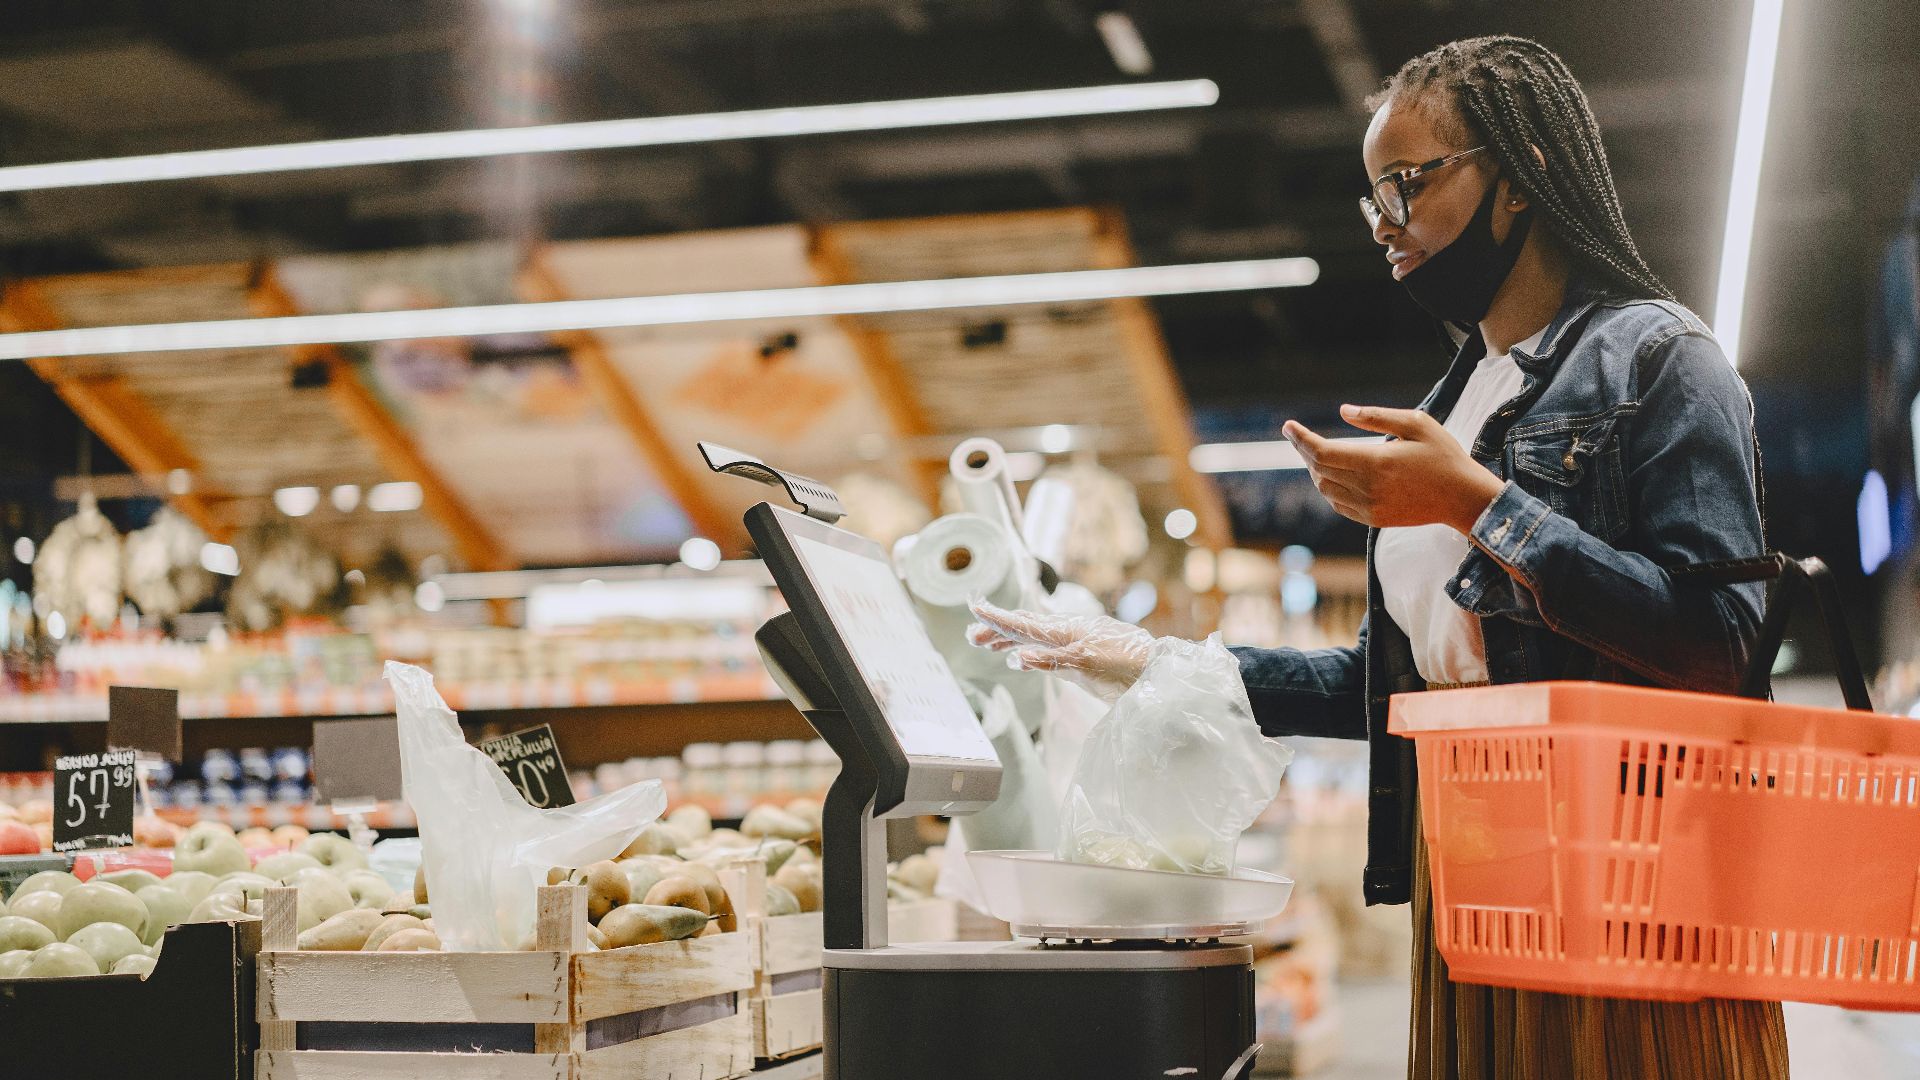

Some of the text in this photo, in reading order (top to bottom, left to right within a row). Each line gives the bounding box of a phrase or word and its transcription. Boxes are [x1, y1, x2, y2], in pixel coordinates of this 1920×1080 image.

[536, 755, 556, 774] 49
[65, 766, 134, 828] 57 99
